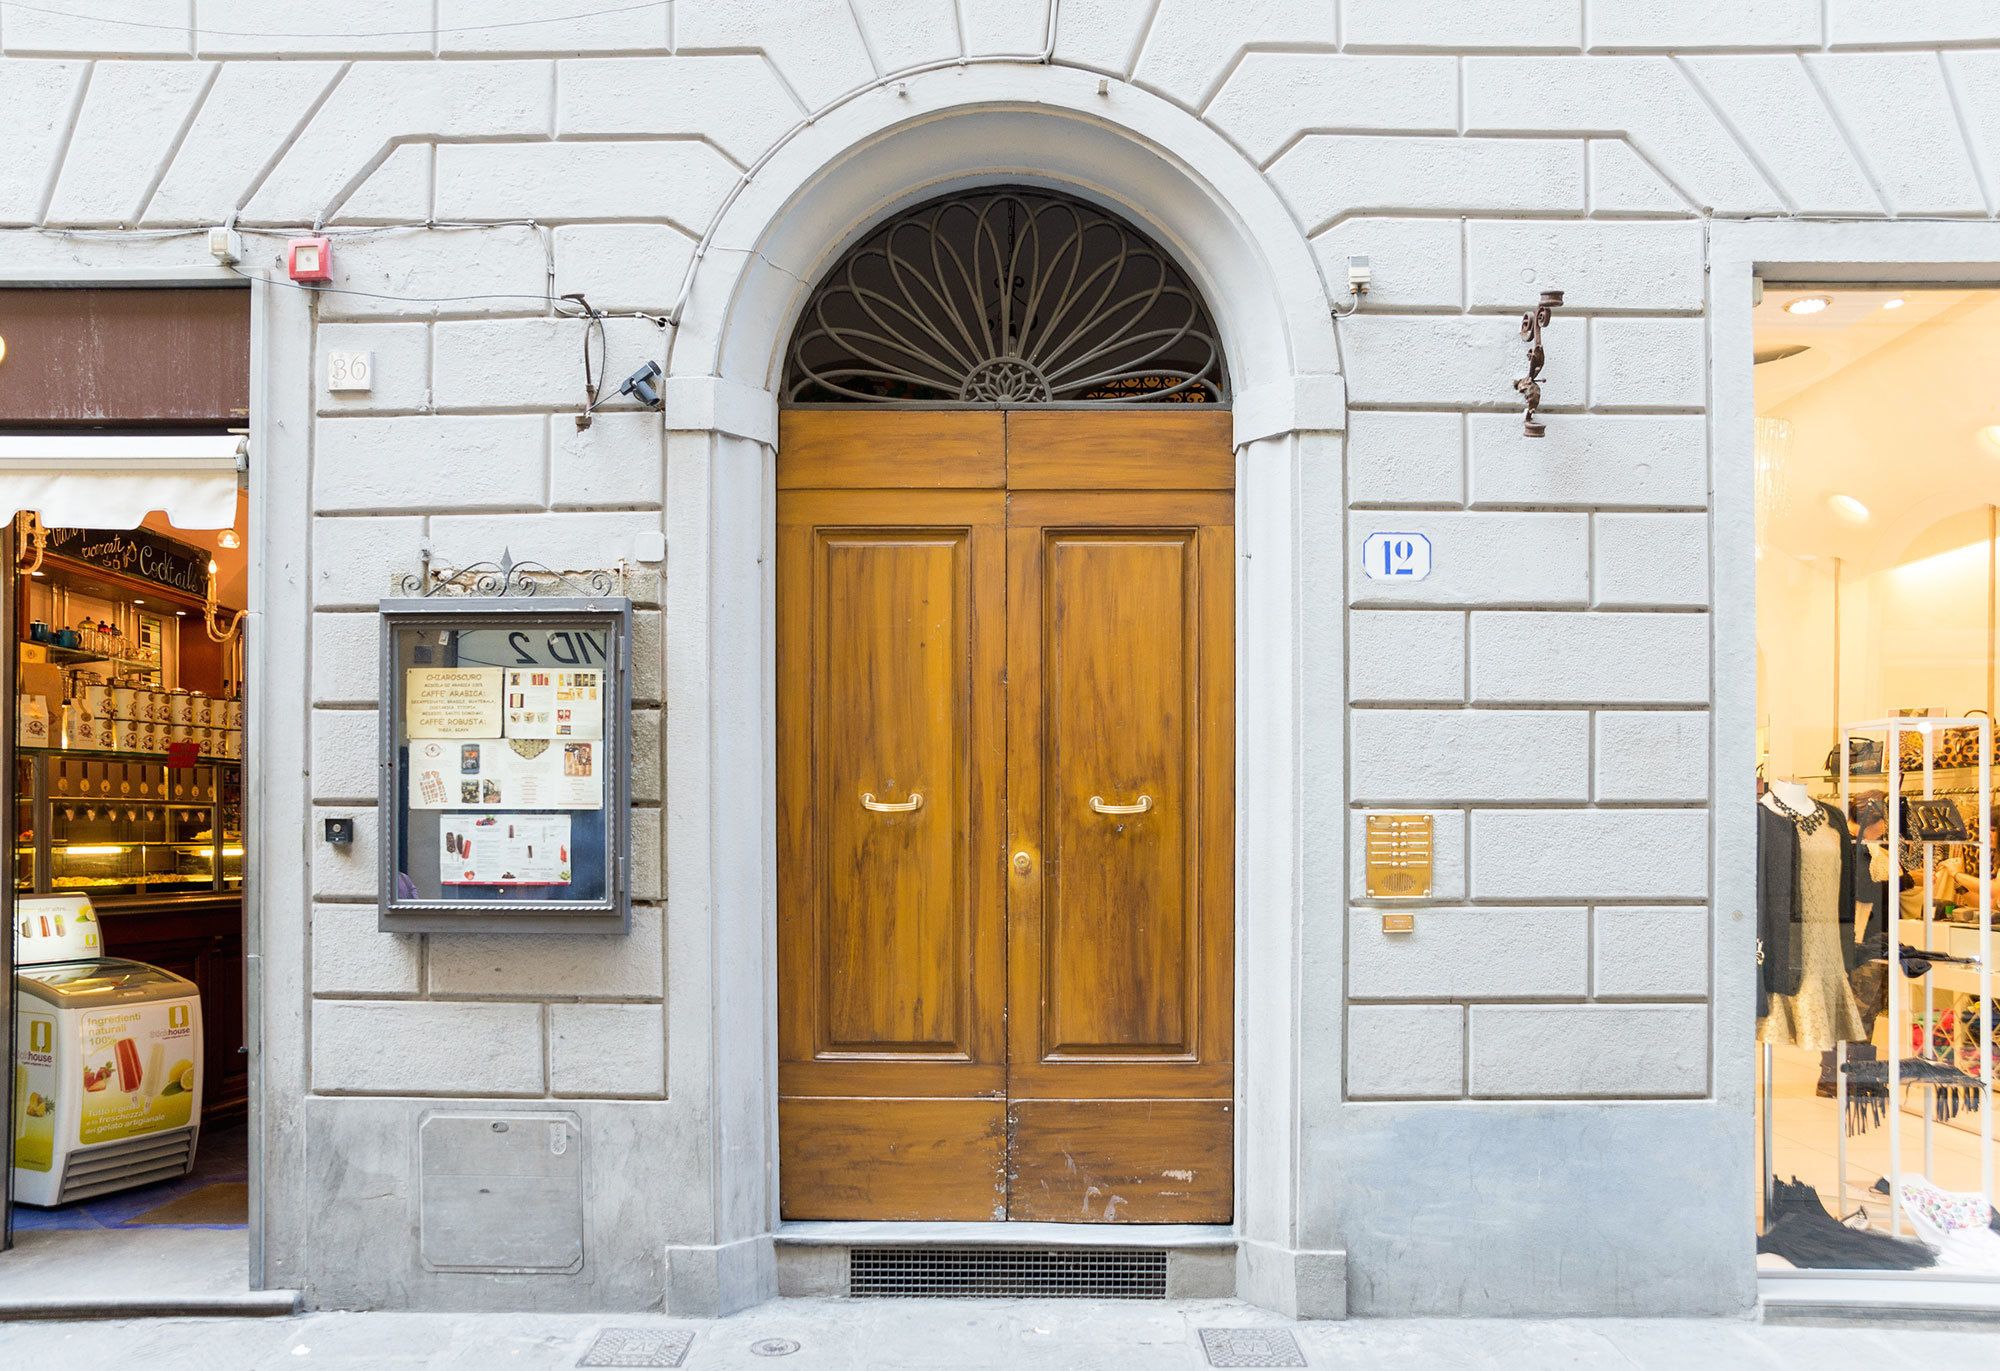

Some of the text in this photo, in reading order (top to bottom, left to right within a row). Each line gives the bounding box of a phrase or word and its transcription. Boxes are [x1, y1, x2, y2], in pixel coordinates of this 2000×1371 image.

[332, 355, 367, 381] 36
[1383, 540, 1413, 575] 12
[140, 545, 198, 592] Cocktails
[87, 1012, 142, 1026] Ingredienti
[89, 1023, 127, 1036] naturali
[97, 1121, 123, 1133] gelato
[124, 1113, 166, 1127] artigianale
[99, 1110, 143, 1123] freschezza
